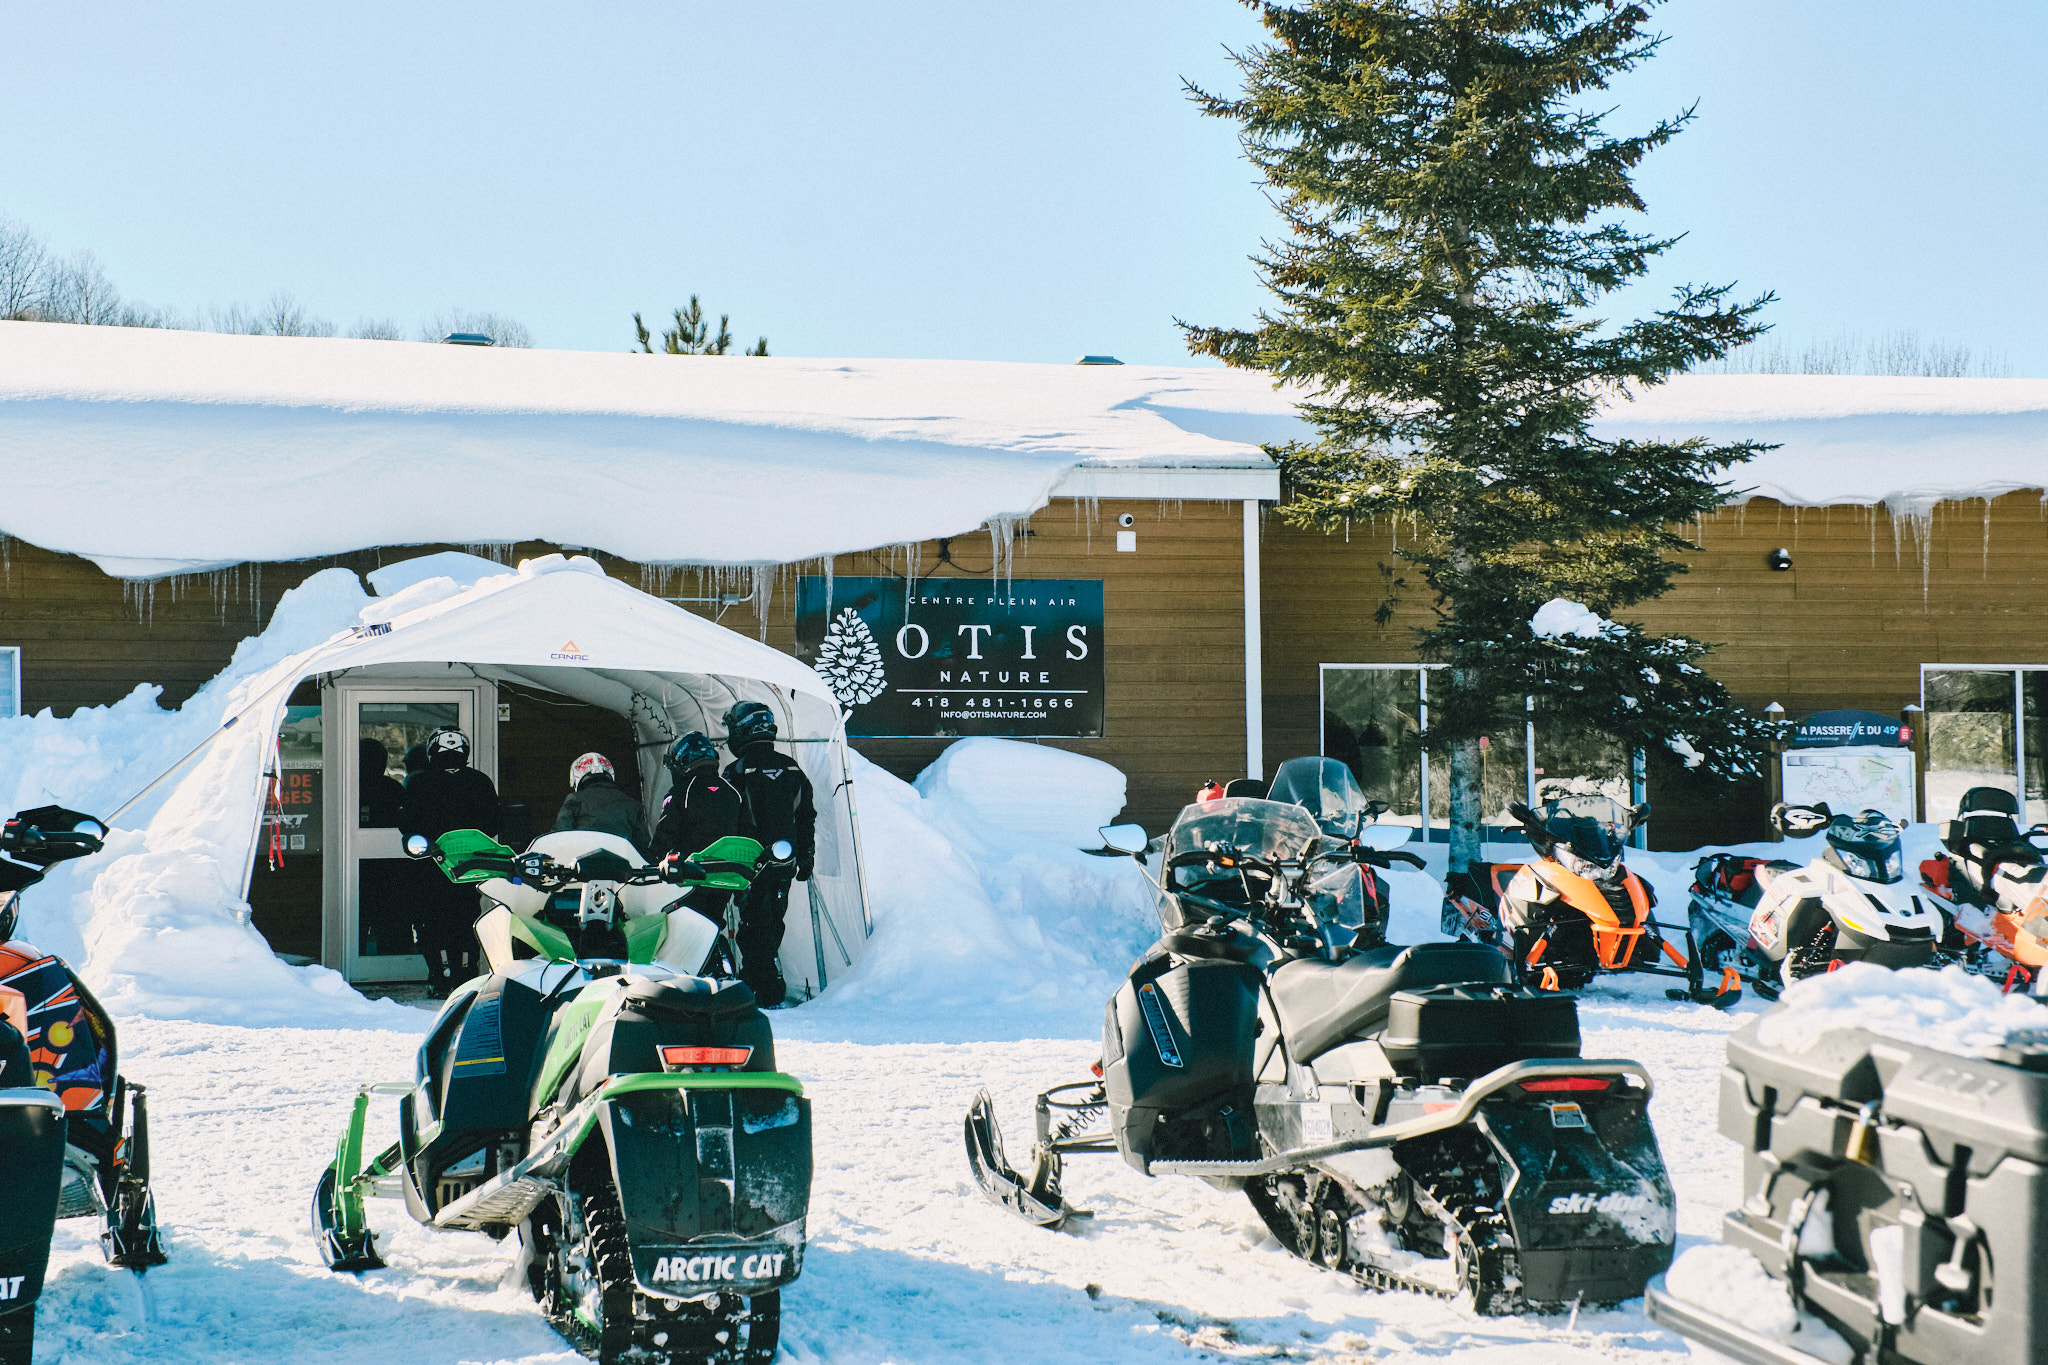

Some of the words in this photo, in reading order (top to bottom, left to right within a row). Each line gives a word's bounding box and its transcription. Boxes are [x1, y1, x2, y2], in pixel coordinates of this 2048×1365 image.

[908, 597, 975, 605] CENTRE
[987, 598, 1037, 606] PLEIN
[1048, 598, 1076, 606] AIR
[896, 623, 1089, 661] OTIS
[550, 653, 589, 661] CANAC
[940, 670, 1050, 684] NATURE
[911, 697, 950, 708] 418
[965, 698, 1074, 708] 481-1666
[940, 711, 1047, 719] INFO@OTISNATURE.COM
[1867, 725, 1882, 736] DU
[289, 774, 312, 788] DE
[652, 1255, 737, 1282] ARCTIC
[741, 1253, 786, 1279] CAT
